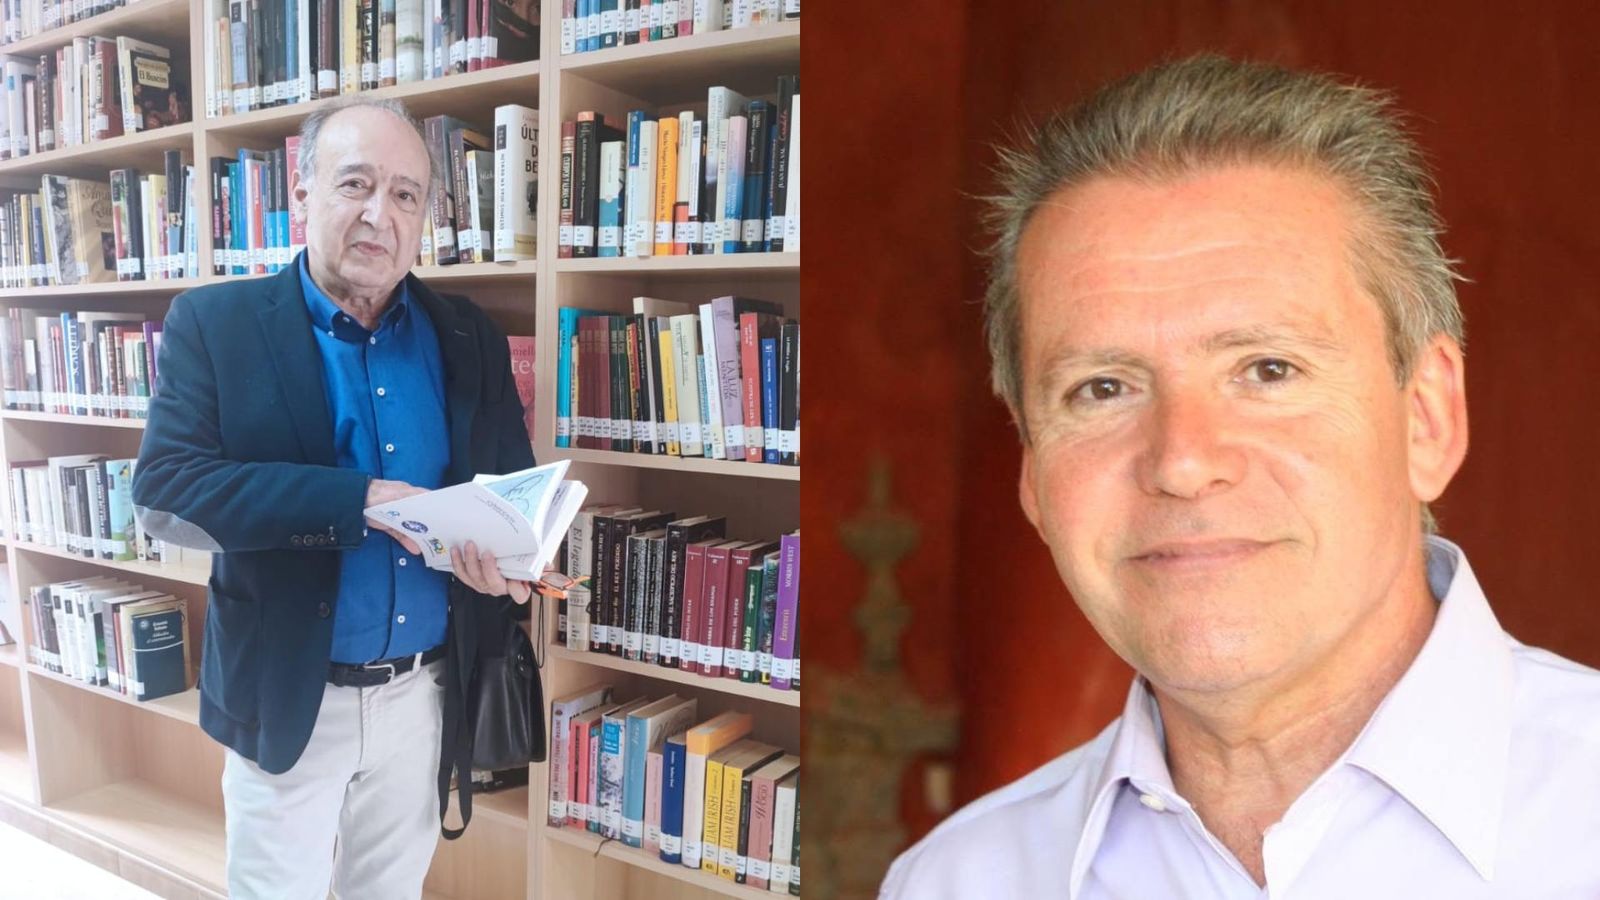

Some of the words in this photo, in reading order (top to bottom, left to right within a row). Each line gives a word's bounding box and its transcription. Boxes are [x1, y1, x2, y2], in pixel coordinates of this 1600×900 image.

[531, 145, 538, 158] D
[525, 160, 538, 173] BE
[726, 360, 736, 374] LA
[728, 377, 738, 398] LUZ
[573, 528, 582, 542] El
[571, 544, 582, 579] legado
[705, 795, 718, 820] IRISH
[723, 800, 735, 826] IRISH
[705, 820, 716, 844] LIAM
[722, 826, 734, 849] LIAM
